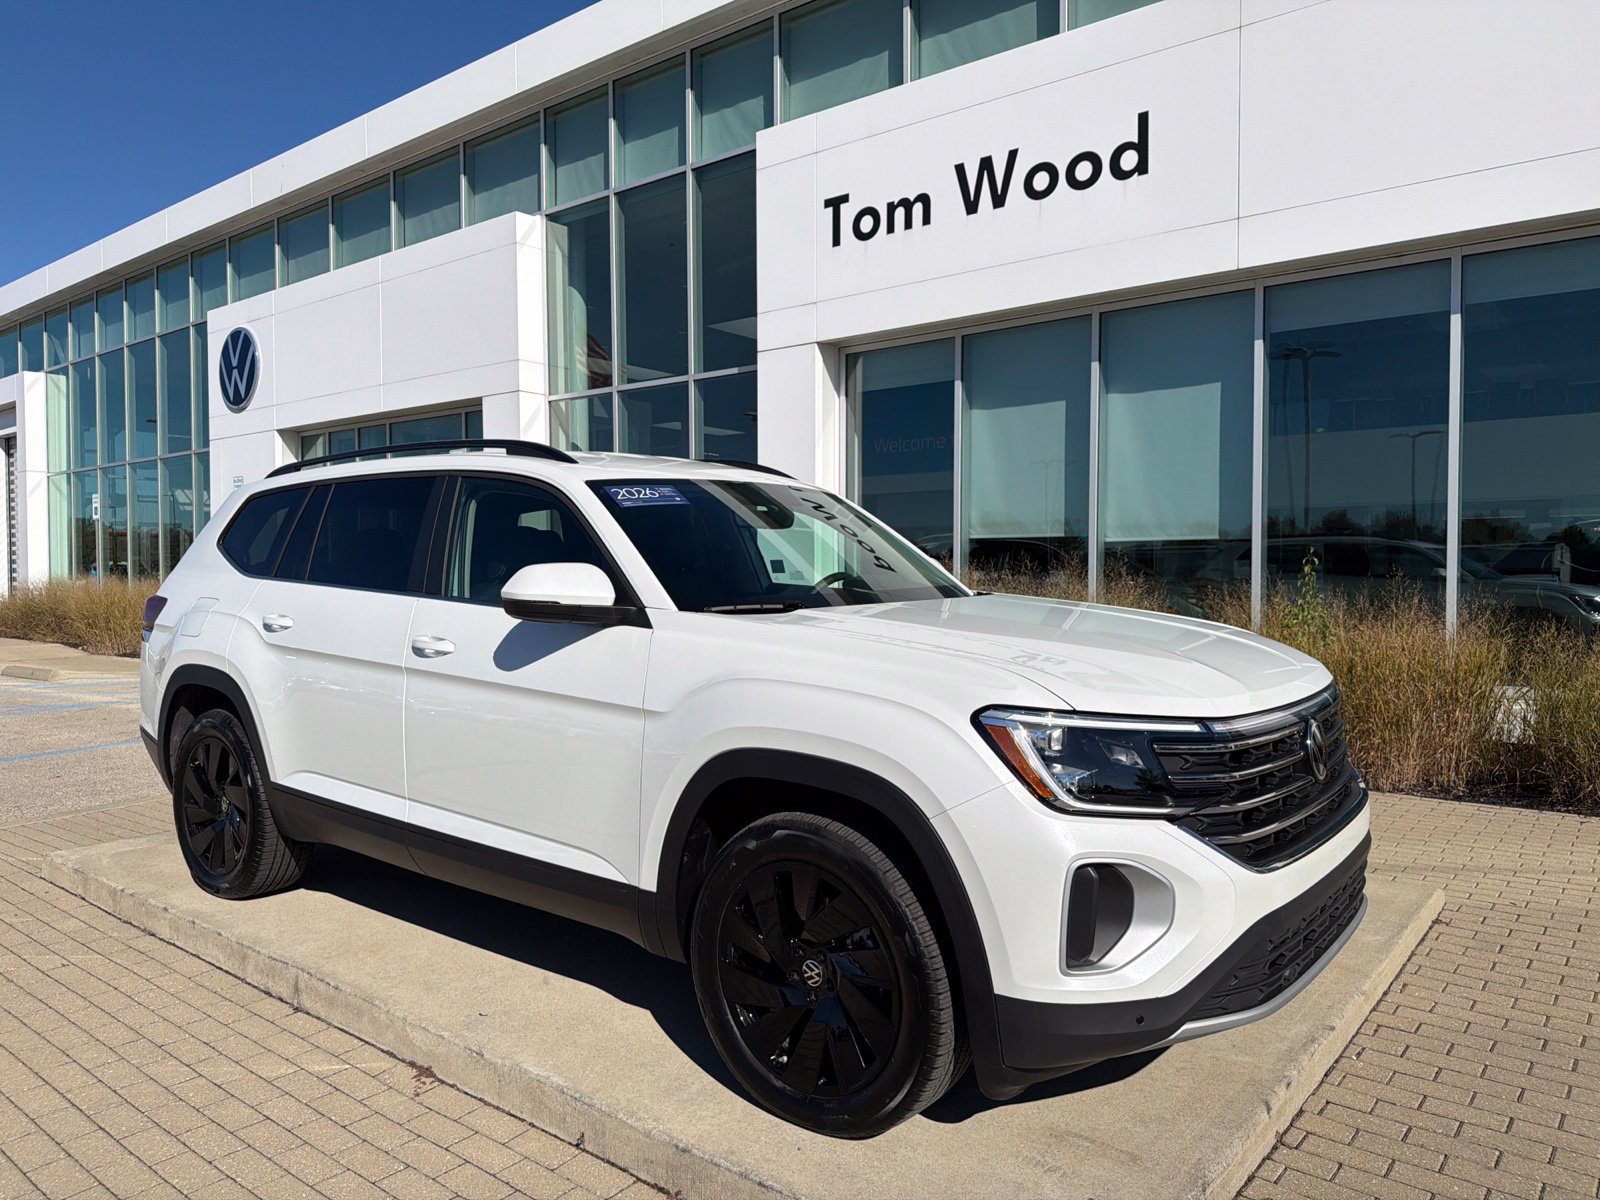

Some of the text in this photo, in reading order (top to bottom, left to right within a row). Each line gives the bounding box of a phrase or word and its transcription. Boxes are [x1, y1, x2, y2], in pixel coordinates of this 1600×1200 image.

[824, 110, 1149, 248] Tom Wood
[873, 435, 946, 454] Welcome
[610, 487, 660, 500] 2026
